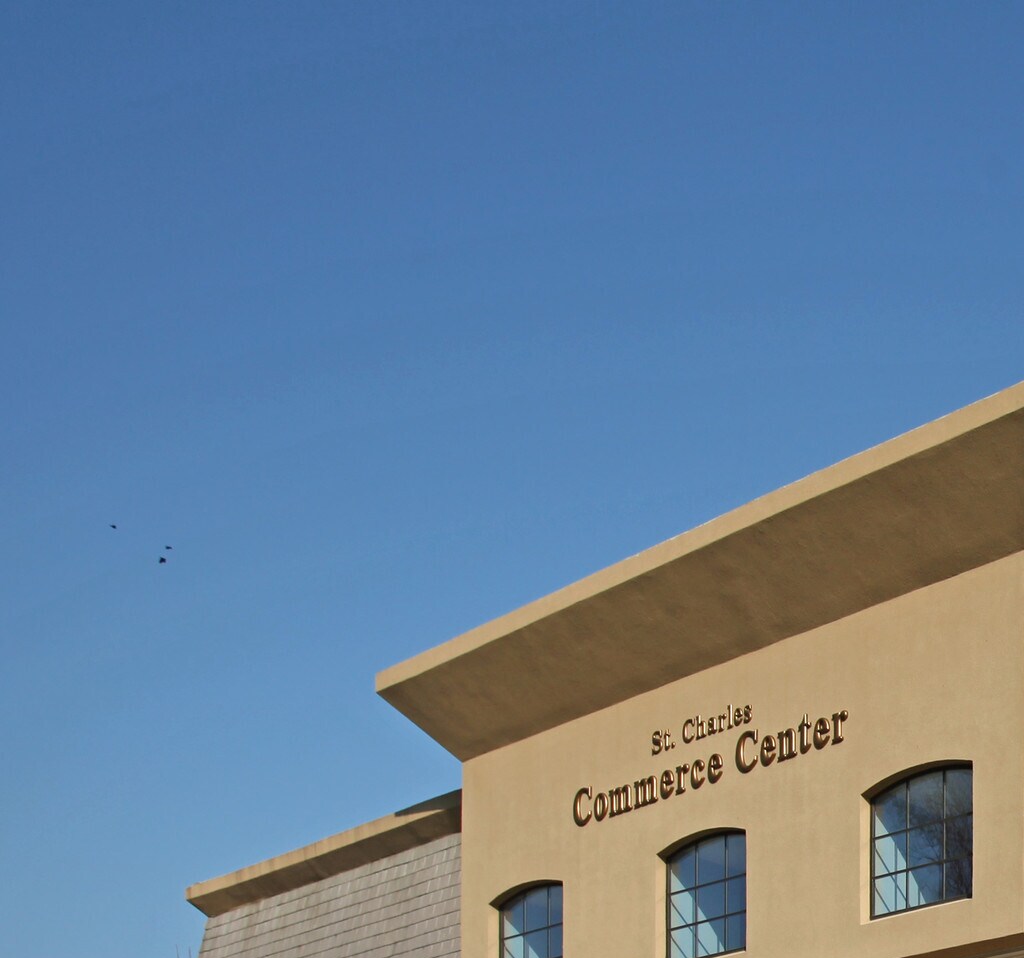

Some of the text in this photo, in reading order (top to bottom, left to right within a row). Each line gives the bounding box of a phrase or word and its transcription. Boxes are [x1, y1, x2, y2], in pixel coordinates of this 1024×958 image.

[573, 709, 849, 827] Commerce Center
[651, 704, 753, 756] St. Charles
